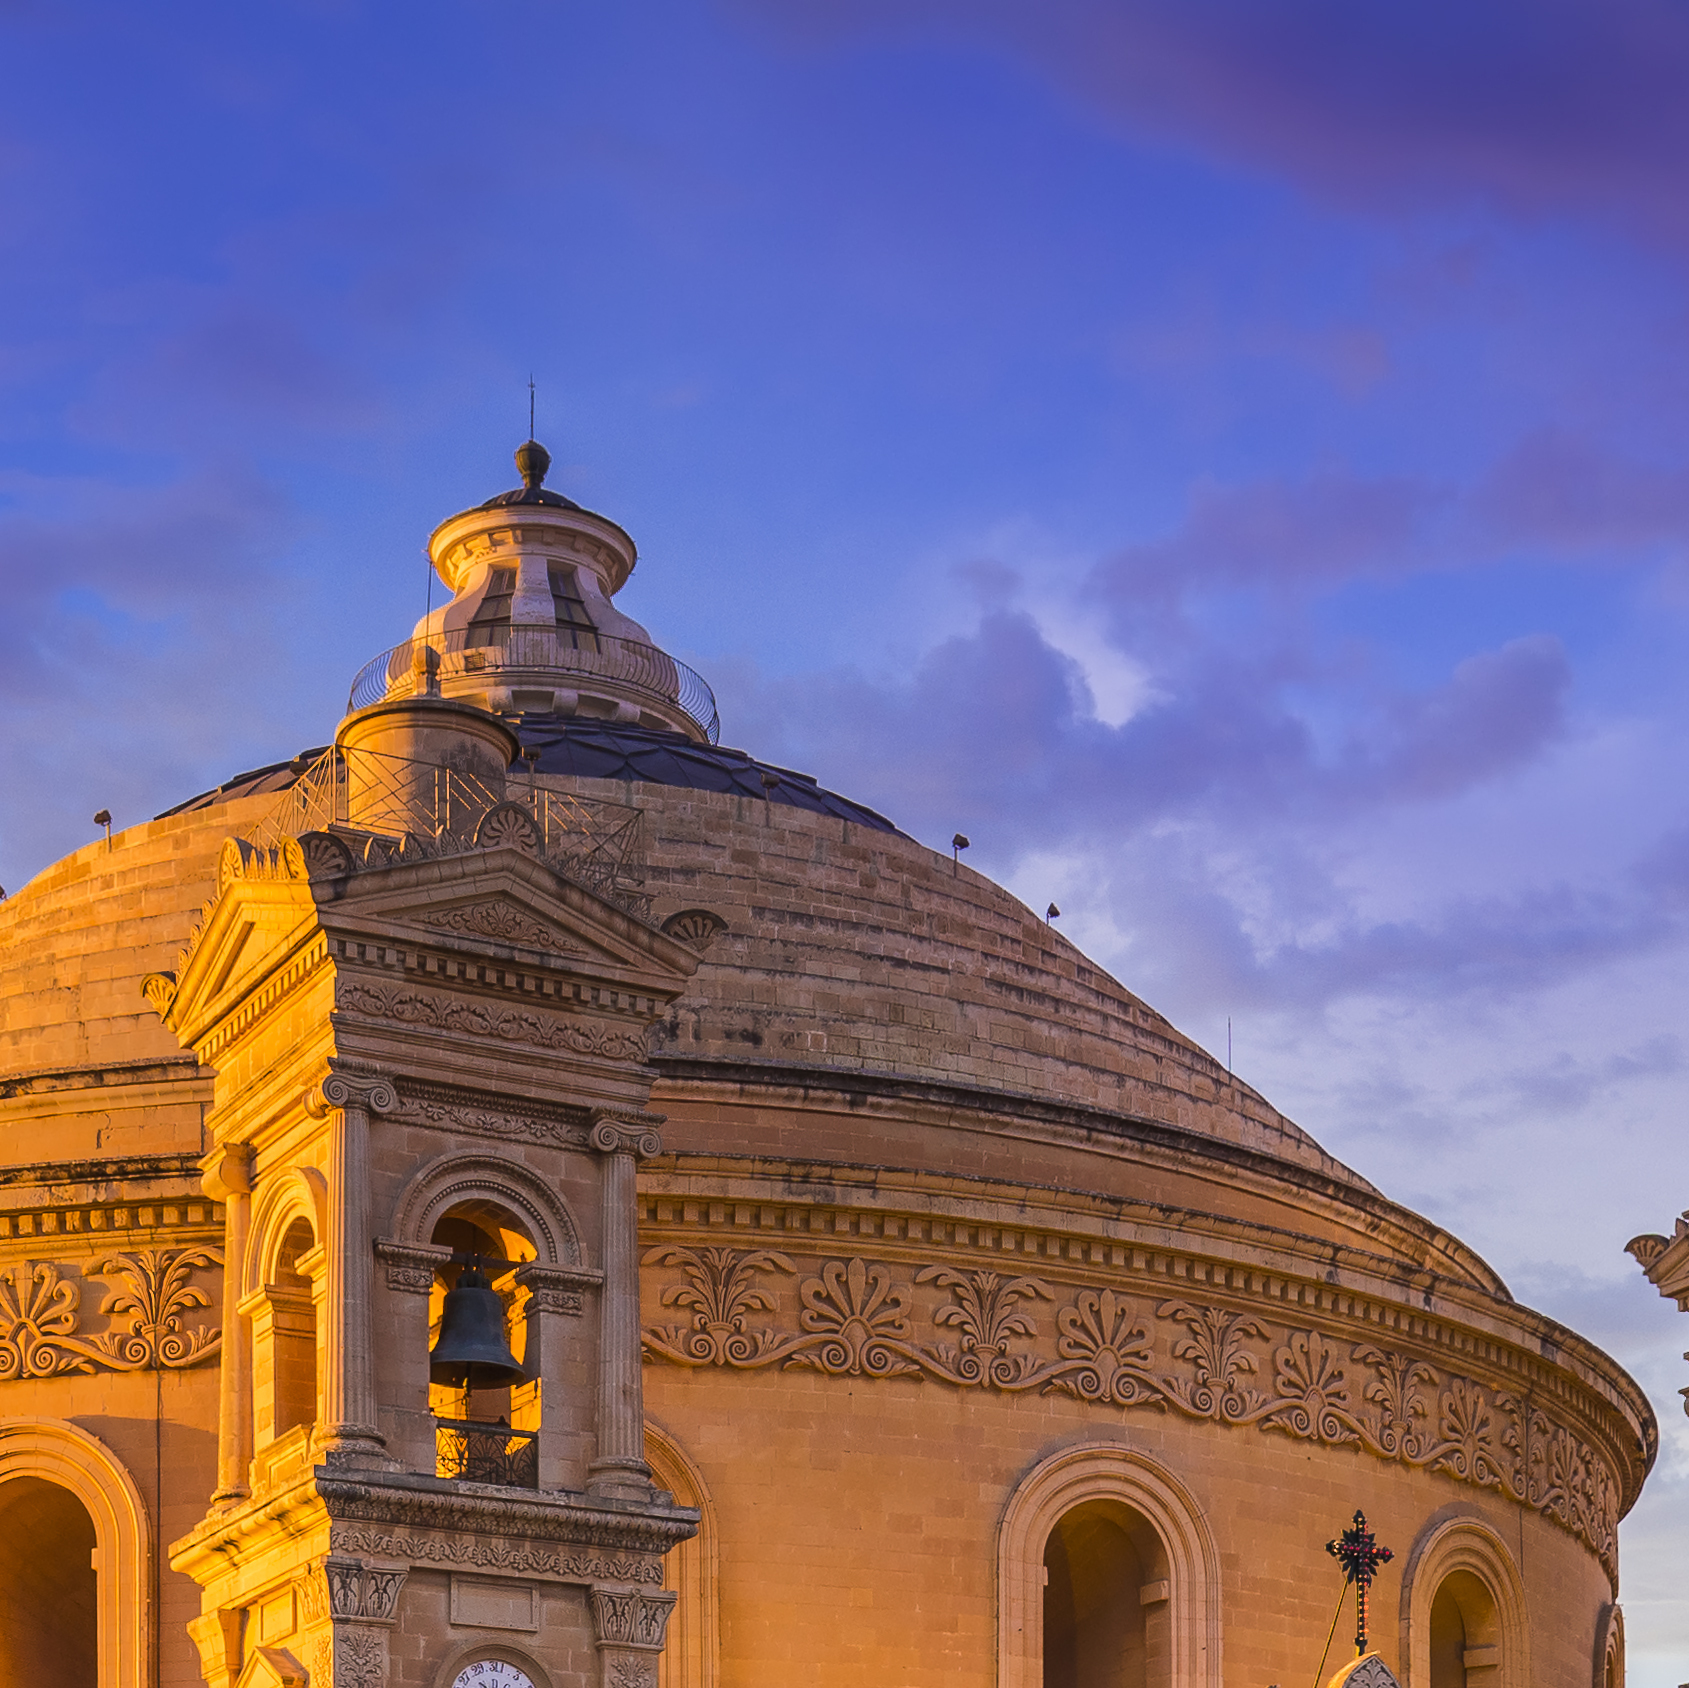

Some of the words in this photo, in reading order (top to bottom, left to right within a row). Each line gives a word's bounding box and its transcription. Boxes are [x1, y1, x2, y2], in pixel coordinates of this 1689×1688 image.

[471, 1663, 484, 1677] 29
[513, 1670, 522, 1680] 3
[458, 1671, 470, 1686] 27
[492, 1679, 498, 1688] D
